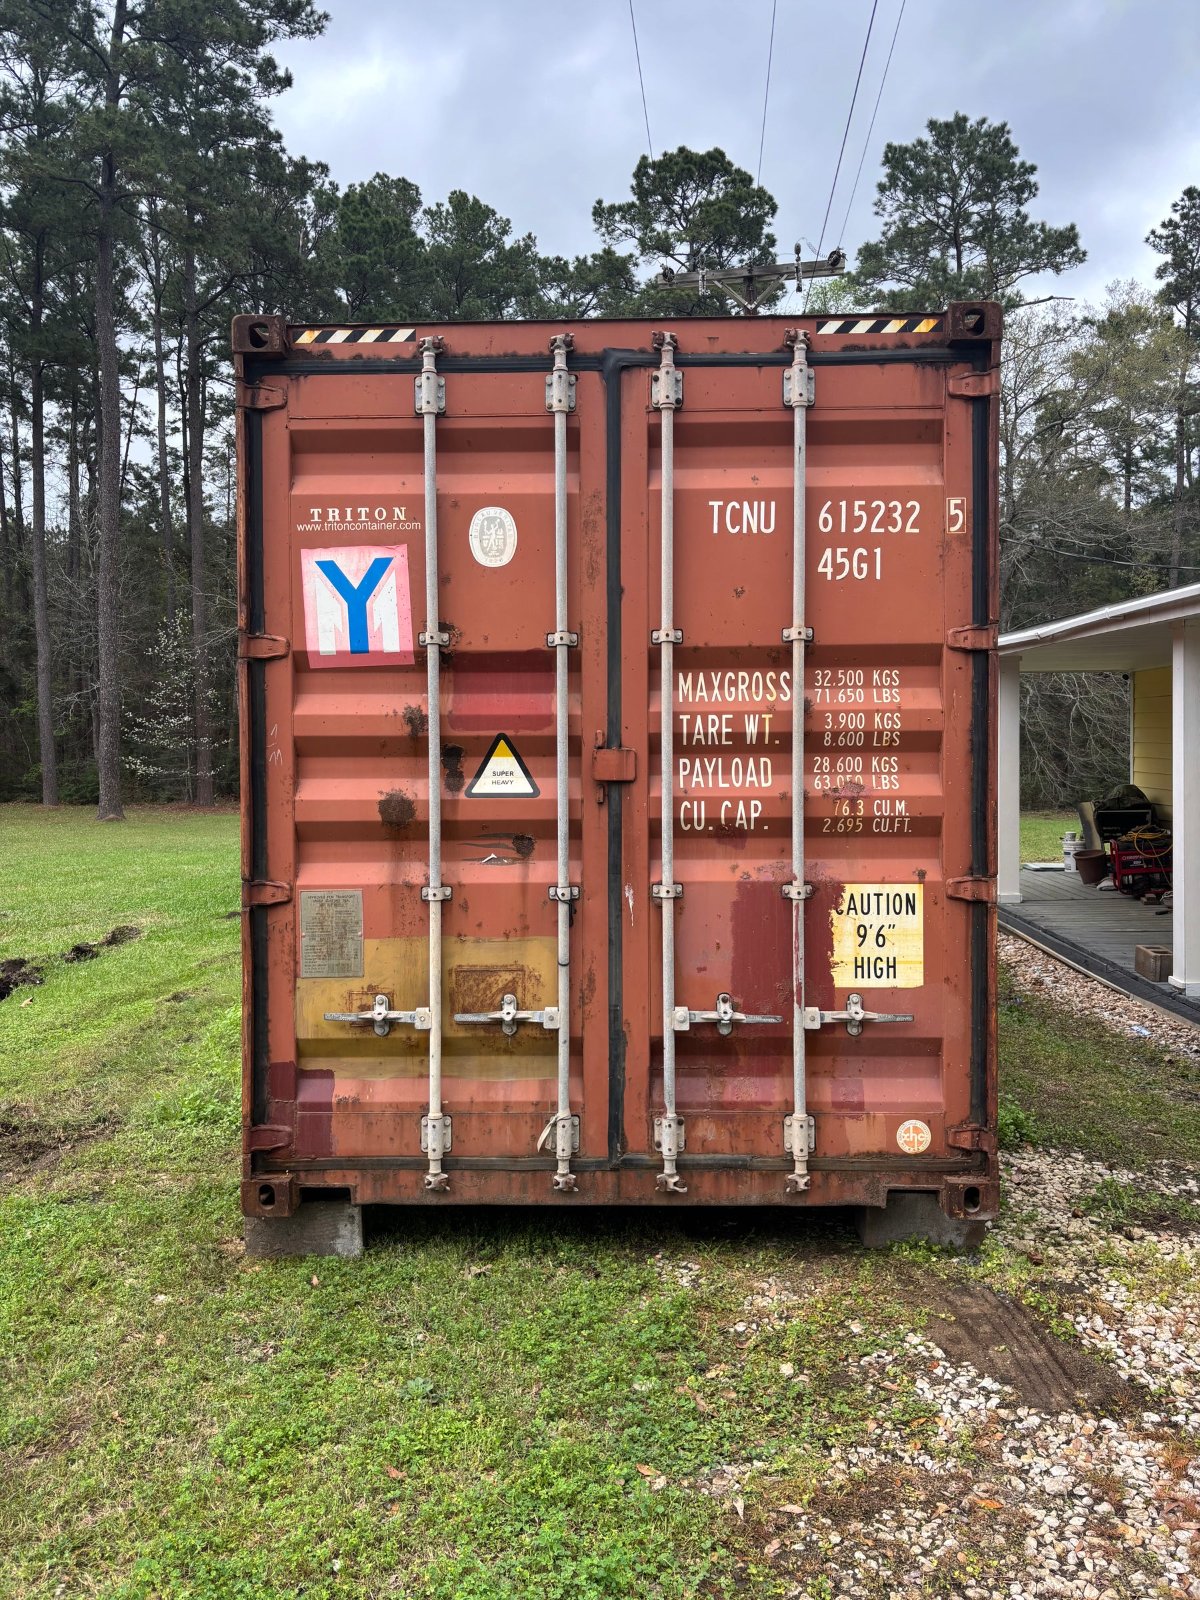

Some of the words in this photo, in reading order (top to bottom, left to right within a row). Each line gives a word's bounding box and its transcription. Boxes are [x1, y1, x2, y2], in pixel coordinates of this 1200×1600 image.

[310, 506, 407, 522] TRITON
[708, 500, 776, 534] TCNU
[818, 500, 921, 533] 615232
[949, 499, 964, 532] 5
[296, 520, 422, 531] www.tritoncontainer.com
[817, 547, 882, 580] 45G1
[678, 671, 791, 703] MAXGROSS
[872, 669, 900, 687] KGS
[873, 688, 901, 703] LBS
[679, 714, 734, 745] TARE
[744, 713, 780, 745] WT.
[874, 712, 902, 730] KGS
[872, 731, 901, 747] LBS
[679, 757, 773, 789] PAYLOAD
[871, 756, 899, 773] KGS
[872, 774, 900, 790] LBS
[680, 800, 714, 831] CU.
[720, 800, 769, 831] CAP.
[833, 799, 865, 816] 76.3
[873, 799, 910, 816] CU.M.
[872, 818, 913, 833] CU.FT.
[854, 956, 897, 979] HIGH
